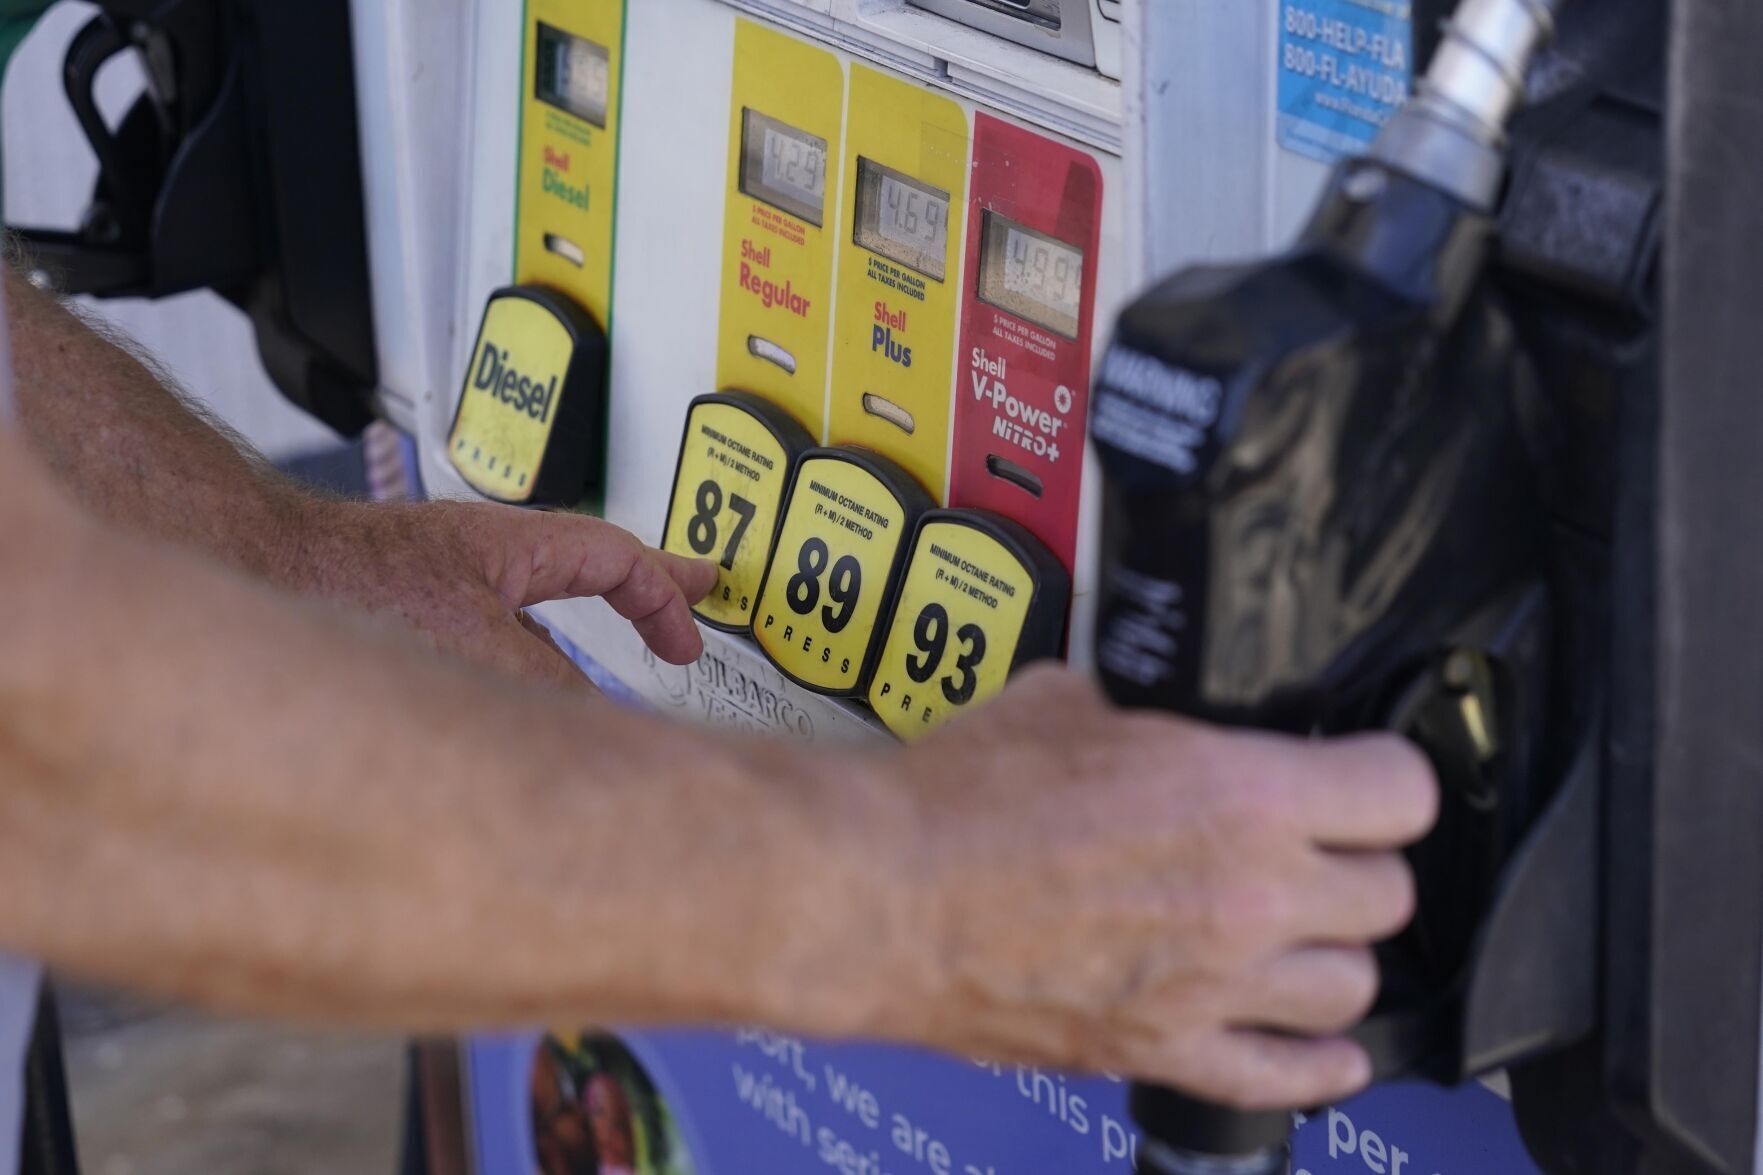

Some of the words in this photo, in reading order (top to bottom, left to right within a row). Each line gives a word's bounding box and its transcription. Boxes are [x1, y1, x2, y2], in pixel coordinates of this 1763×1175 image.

[1285, 5, 1405, 69] 800-HELP-FLA
[1285, 43, 1407, 105] 800-FL-AYUDA
[542, 166, 590, 212] Diesel
[771, 137, 821, 191] 4.29
[752, 215, 760, 226] ALL
[761, 219, 778, 234] TAXES
[778, 228, 805, 246] INCLUDED
[772, 213, 782, 224] PER
[783, 219, 805, 235] GALLON
[888, 184, 942, 242] 4.69
[741, 238, 771, 268] Shell
[873, 258, 889, 274] PRICE
[890, 267, 900, 279] PER
[901, 272, 926, 290] GALLON
[739, 261, 811, 318] Regular
[867, 269, 877, 280] ALL
[878, 273, 895, 288] TAXES
[896, 282, 925, 301] INCLUDED
[874, 301, 906, 332] Shell
[999, 315, 1016, 331] PRICE
[1017, 324, 1029, 337] PER
[1030, 330, 1056, 349] GALLON
[872, 323, 912, 368] Plus
[971, 347, 1006, 379] Shell
[992, 326, 1003, 337] ALL
[1004, 330, 1023, 347] TAXES
[1024, 340, 1056, 361] INCLUDED
[474, 341, 558, 424] Diesel
[971, 370, 1062, 437] V-Power
[701, 424, 728, 445] MINIMUM
[727, 437, 751, 459] OCTANE
[751, 450, 774, 471] RATING
[735, 460, 760, 482] METHOD
[687, 479, 757, 572] 87
[809, 479, 838, 502] MINIMUM
[838, 494, 864, 516] OCTANE
[864, 508, 889, 529] RATING
[845, 518, 873, 540] METHOD
[786, 536, 862, 634] 89
[930, 543, 960, 568] MINIMUM
[960, 560, 988, 583] OCTANE
[988, 575, 1016, 597] RATING
[968, 584, 998, 609] METHOD
[764, 614, 850, 673] PRESS
[906, 603, 986, 706] 93
[697, 651, 815, 742] GILBARCO
[880, 682, 932, 723] PRE
[732, 1063, 811, 1146] with
[823, 1063, 881, 1129] we
[891, 1113, 951, 1175] are
[1014, 1062, 1090, 1135] this
[1328, 1106, 1408, 1175] per
